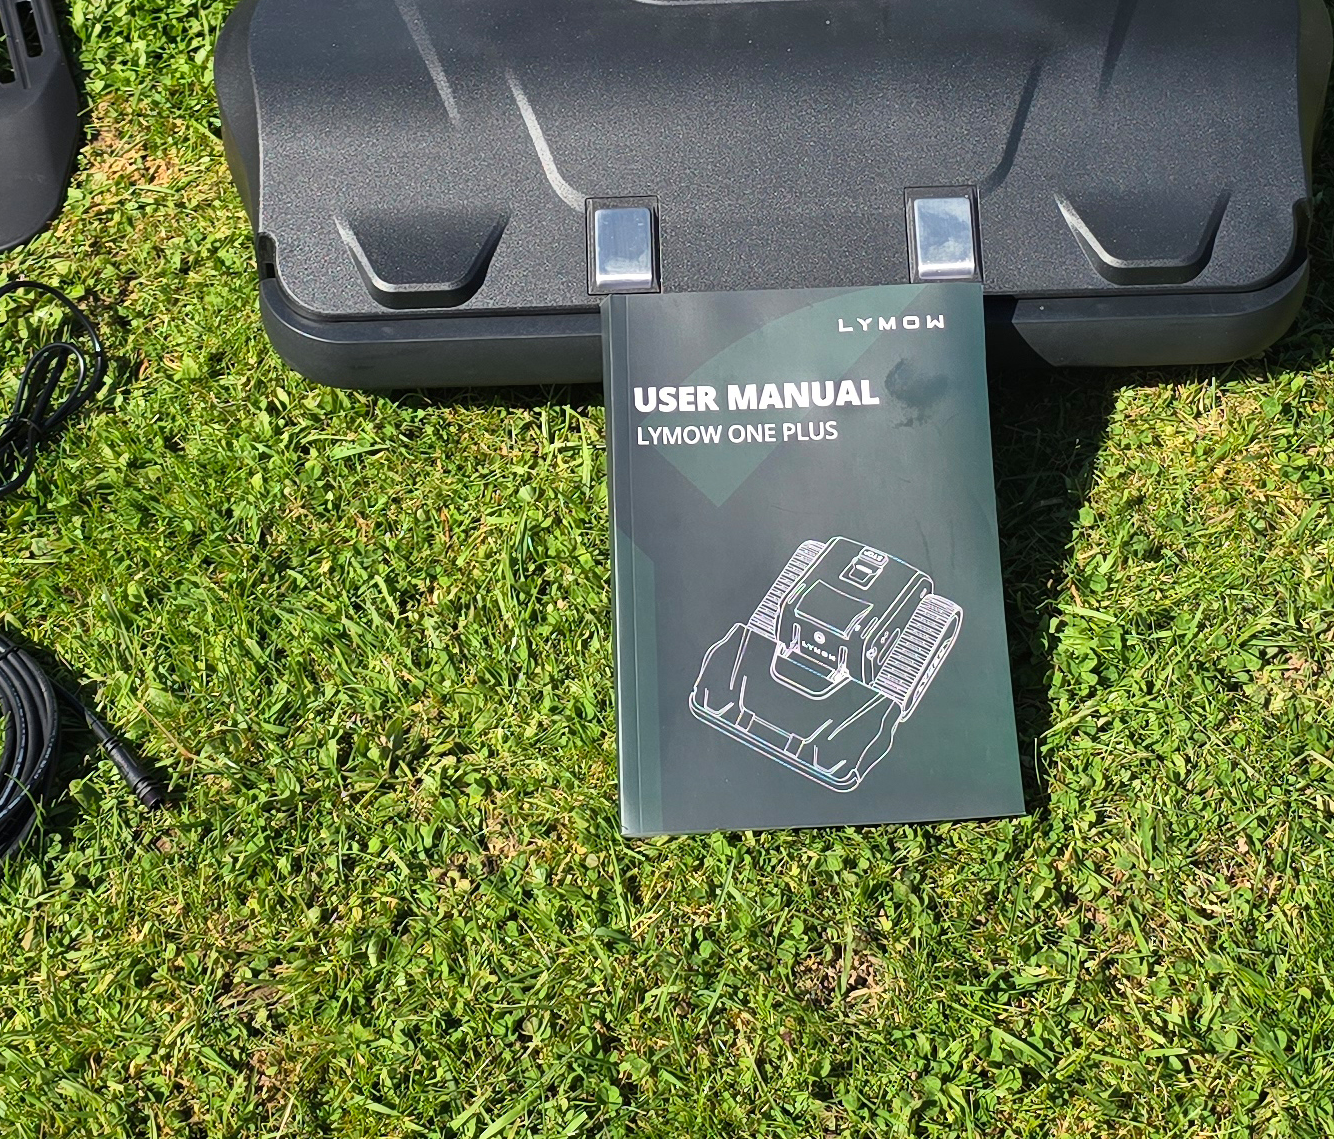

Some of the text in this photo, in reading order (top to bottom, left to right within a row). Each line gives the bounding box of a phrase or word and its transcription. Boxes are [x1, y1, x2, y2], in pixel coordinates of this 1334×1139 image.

[837, 314, 945, 333] LYMOW
[633, 379, 880, 413] USER MANUAL
[637, 420, 839, 446] LYMOW ONE PLUS
